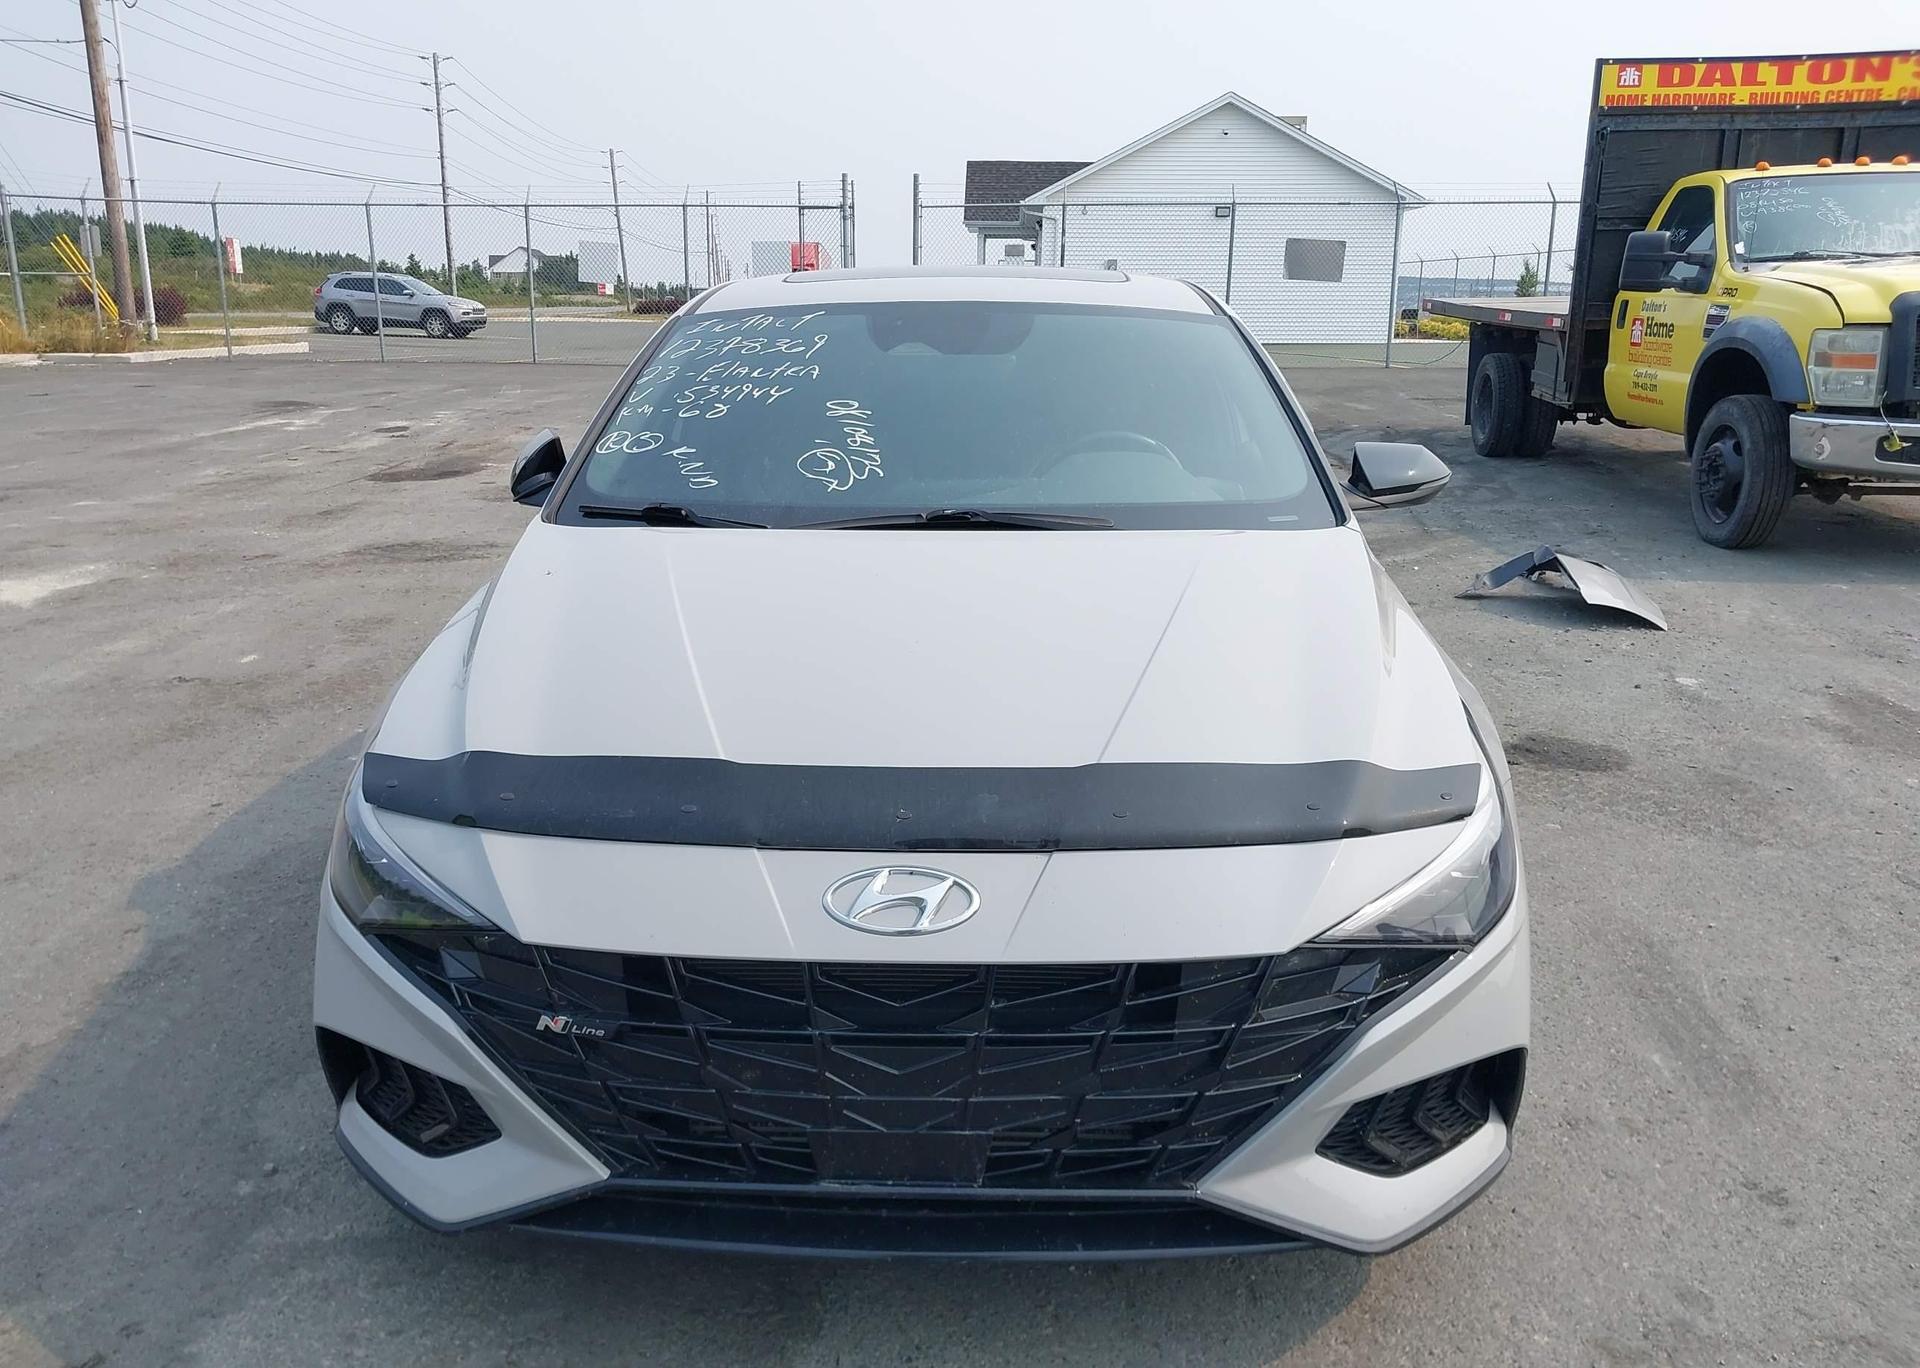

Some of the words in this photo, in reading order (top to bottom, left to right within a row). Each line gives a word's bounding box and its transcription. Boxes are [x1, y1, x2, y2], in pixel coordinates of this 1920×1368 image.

[1657, 54, 1920, 88] DALTON'
[1605, 92, 1648, 106] HOME
[1651, 91, 1737, 106] HARDWARE
[1748, 90, 1820, 105] BUILDING
[1824, 87, 1883, 103] CENTRE
[1641, 299, 1668, 313] Dalton's
[1644, 316, 1675, 339] Home
[1628, 349, 1652, 368] building
[571, 1024, 606, 1037] Line
